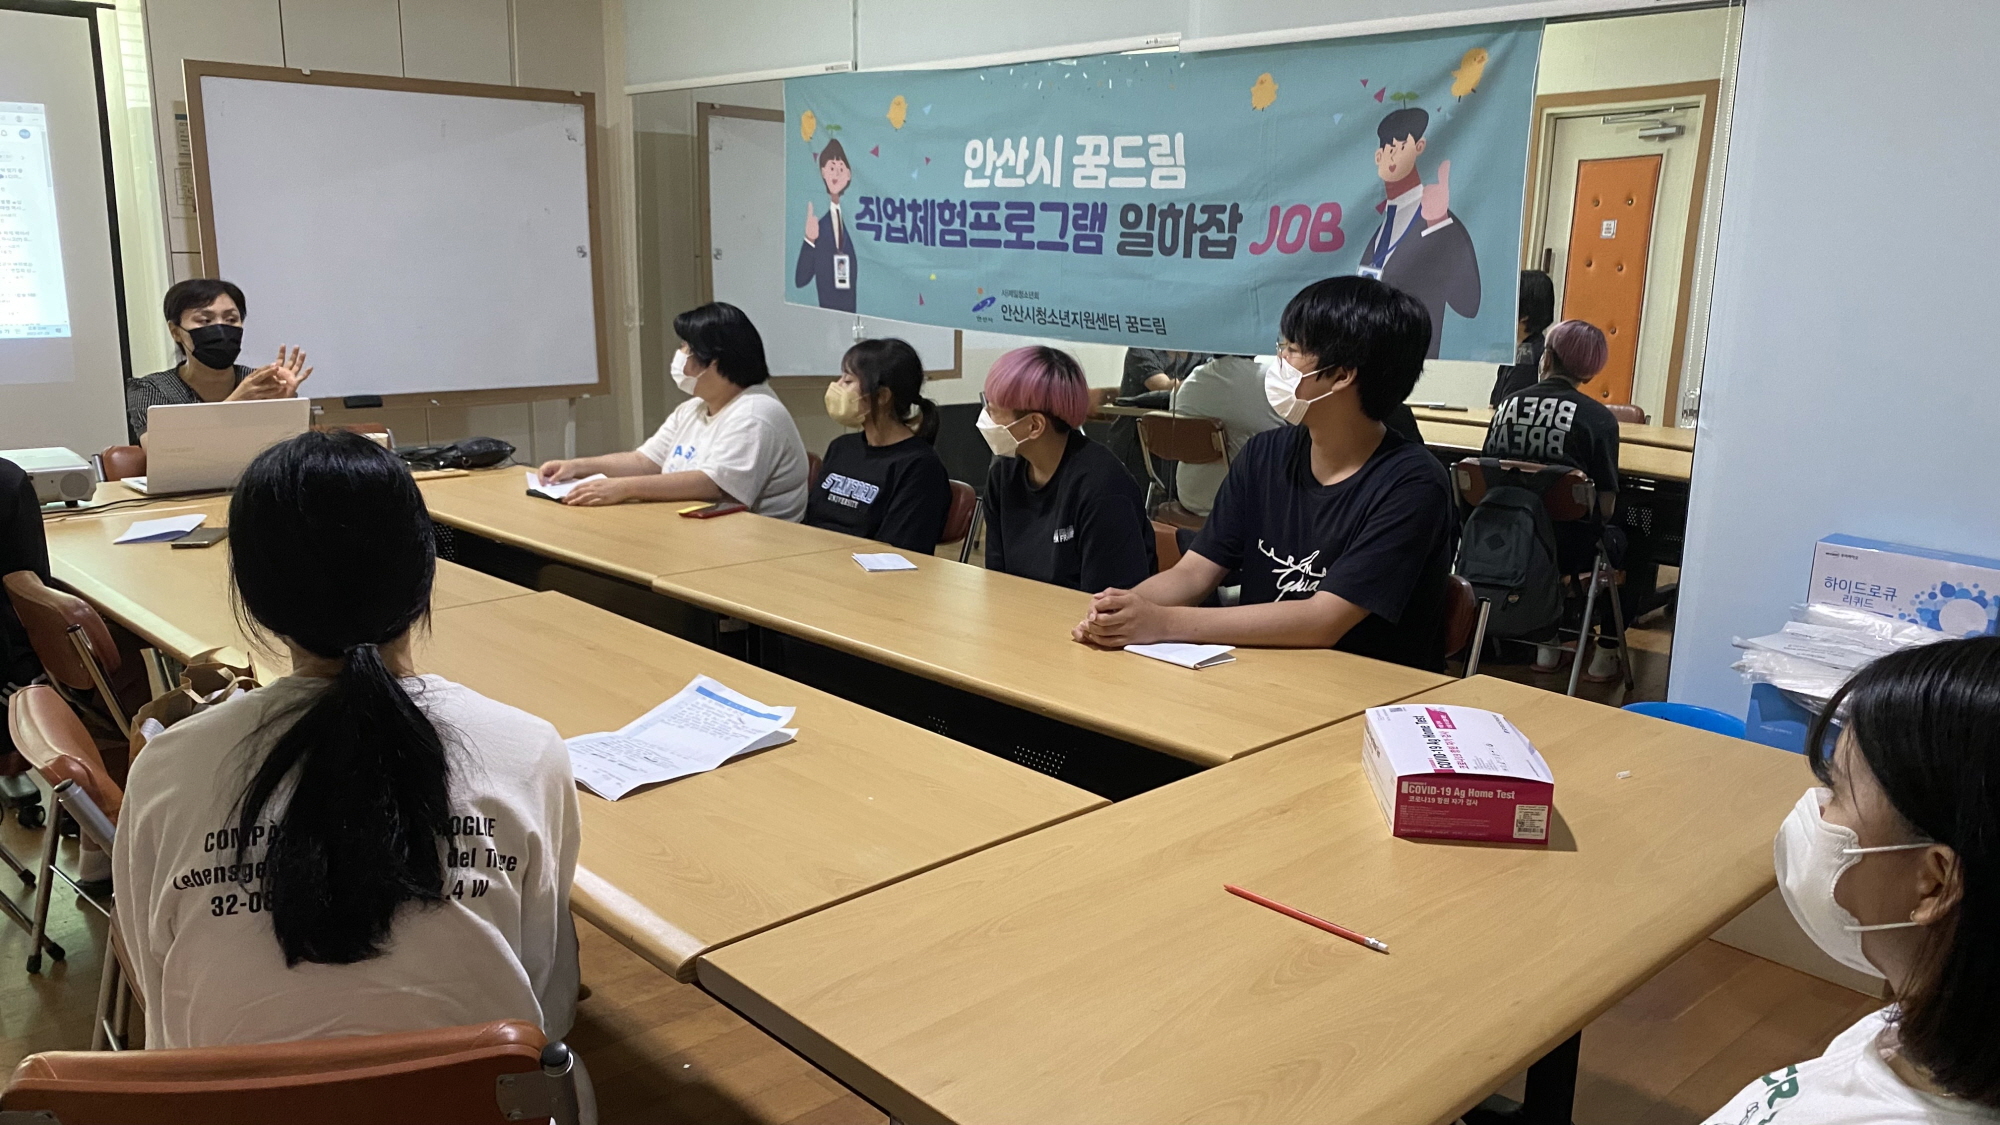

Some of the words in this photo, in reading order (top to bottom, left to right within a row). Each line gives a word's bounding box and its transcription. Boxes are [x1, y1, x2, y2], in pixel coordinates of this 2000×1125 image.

[963, 134, 1063, 188] 안산시
[1072, 133, 1186, 189] 꿈드림
[855, 196, 1108, 255] 직업체험프로그램
[1116, 202, 1243, 259] 일하잡
[1249, 202, 1345, 255] JOB
[1001, 304, 1121, 332] 안산시청소년지원센터
[1125, 315, 1167, 335] 꿈드림
[821, 473, 880, 504] STANFORD
[1824, 576, 1897, 602] 하이드로큐
[1842, 594, 1874, 609] 리퀴드
[1430, 744, 1453, 769] COVID-19
[1409, 784, 1451, 796] COVID-19
[1454, 787, 1466, 799] Ag
[1468, 789, 1493, 799] Home
[1497, 790, 1515, 800] Test
[1466, 798, 1478, 806] 검사
